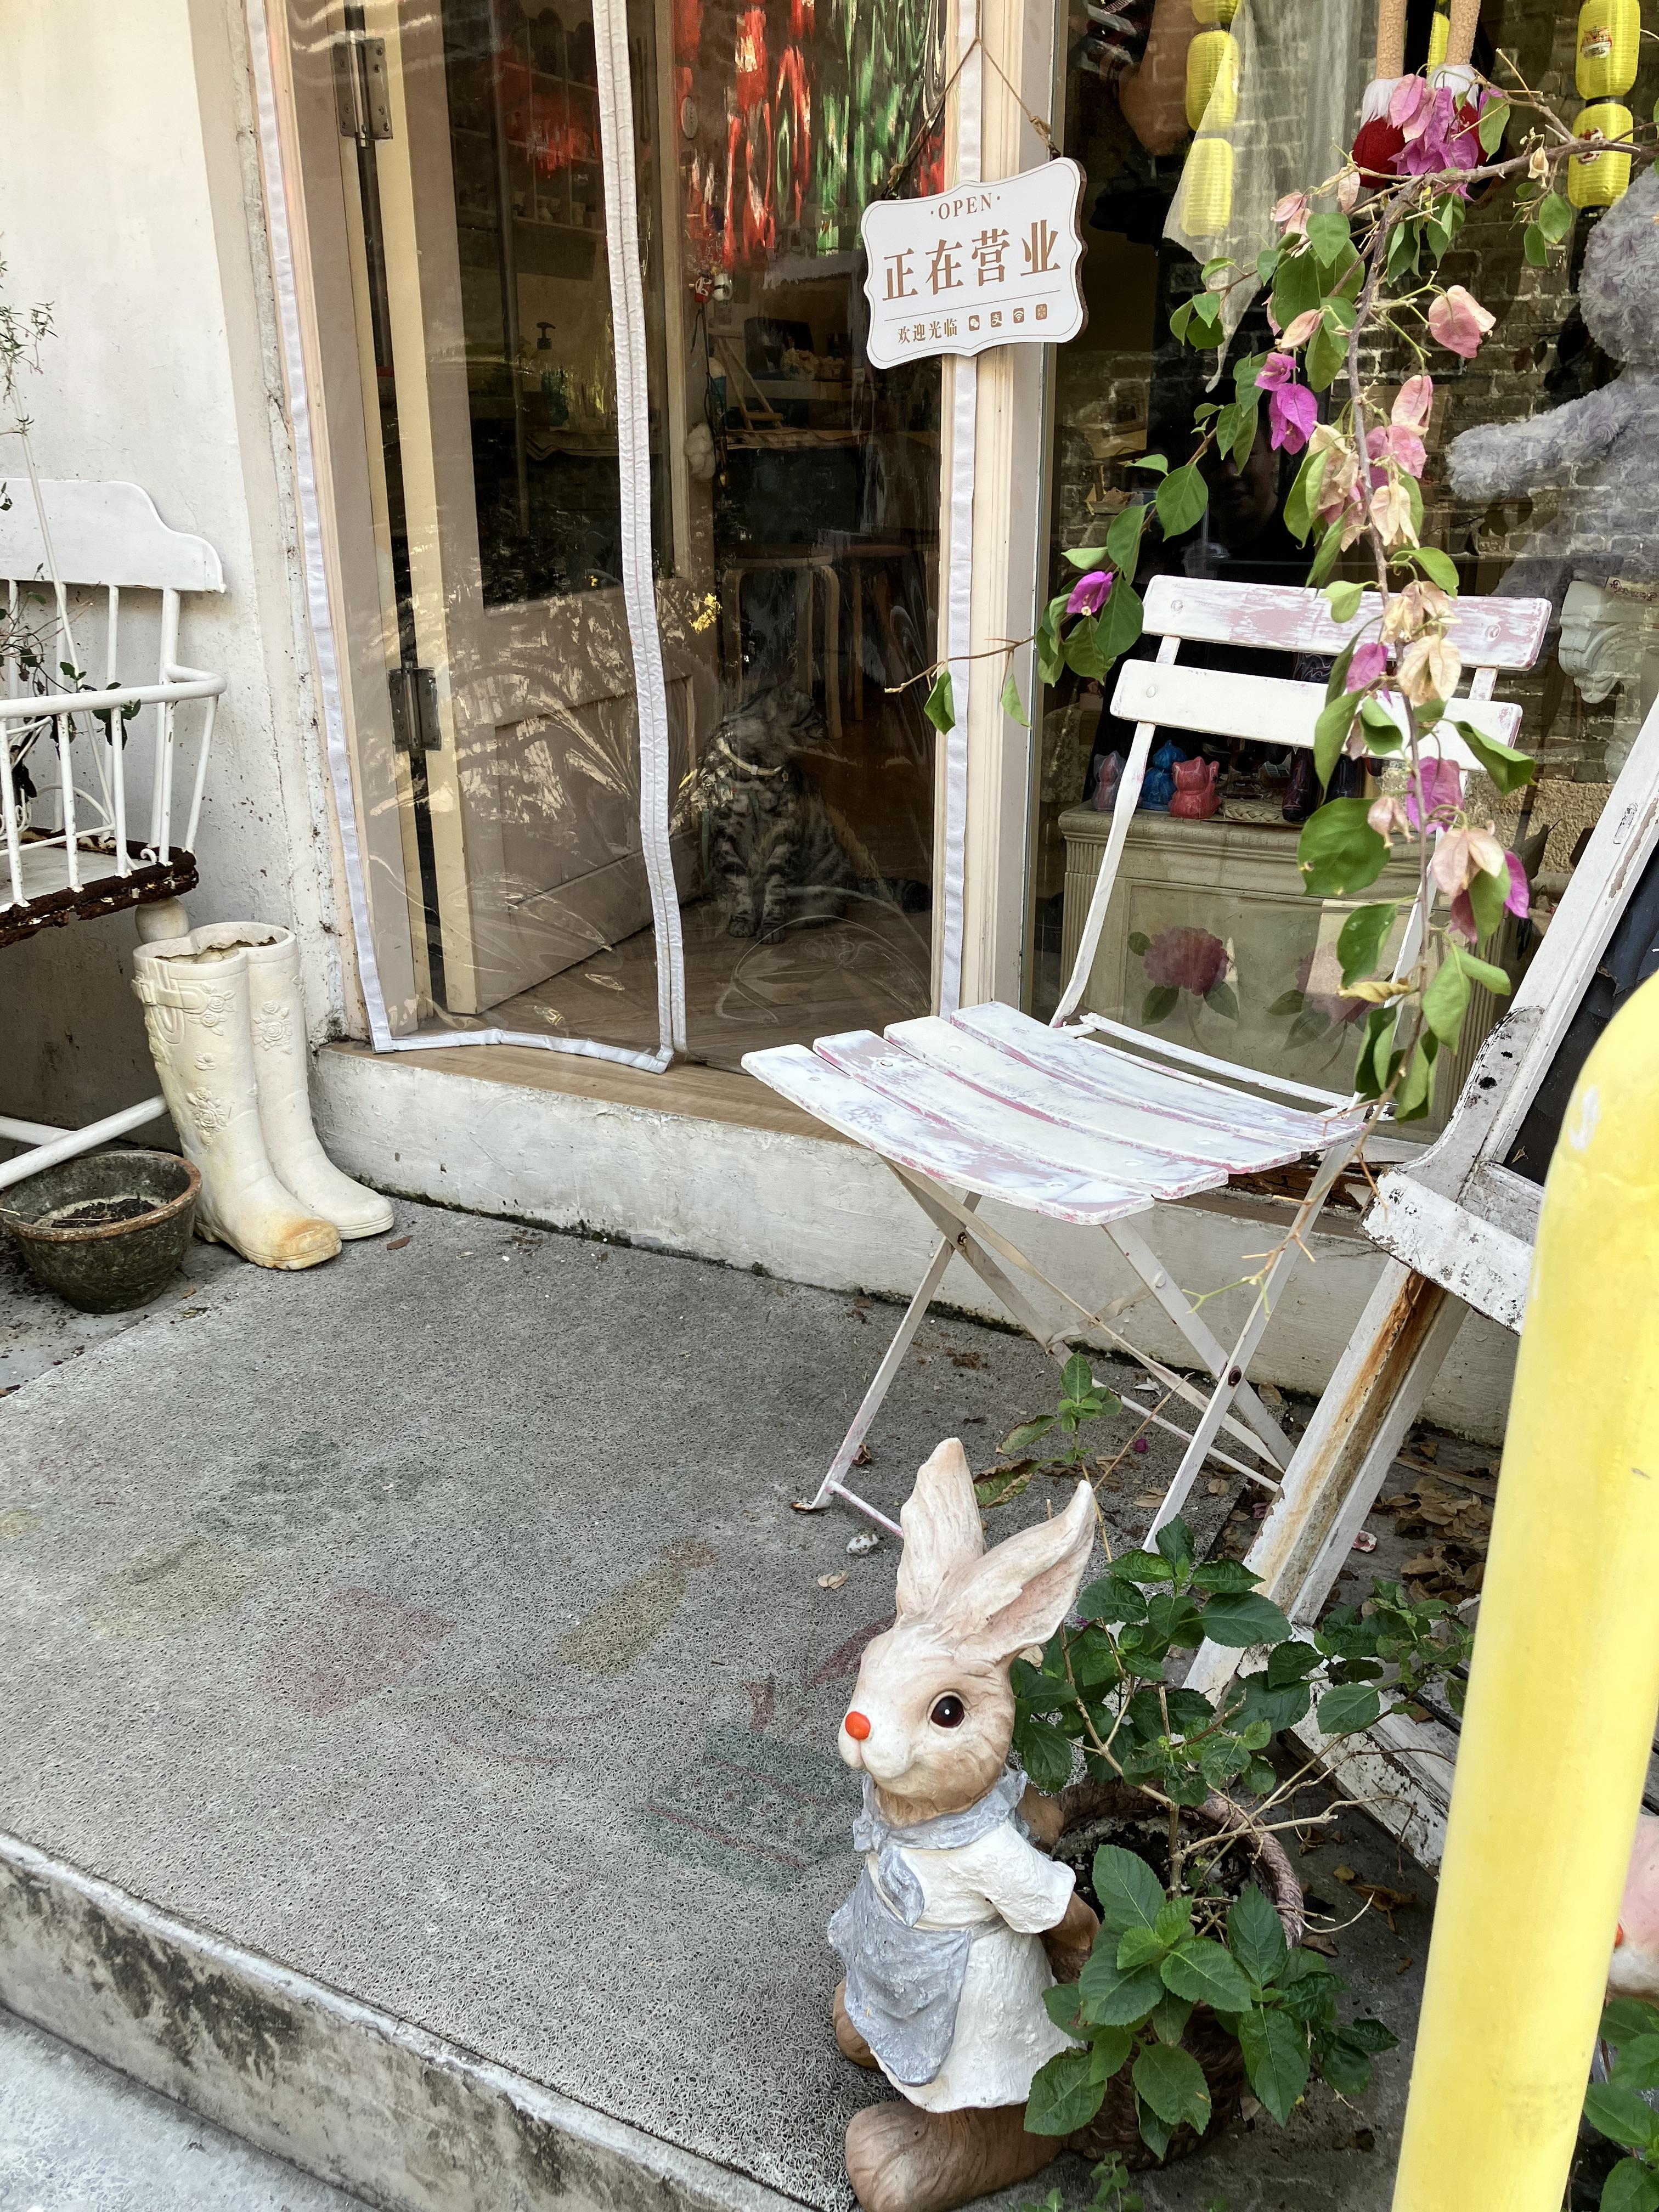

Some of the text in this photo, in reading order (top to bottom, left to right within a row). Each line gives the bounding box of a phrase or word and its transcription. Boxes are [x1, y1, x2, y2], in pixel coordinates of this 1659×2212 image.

[938, 193, 992, 219] OPEN
[882, 219, 1061, 301] 正在营业
[898, 318, 958, 344] 欢迎光临
